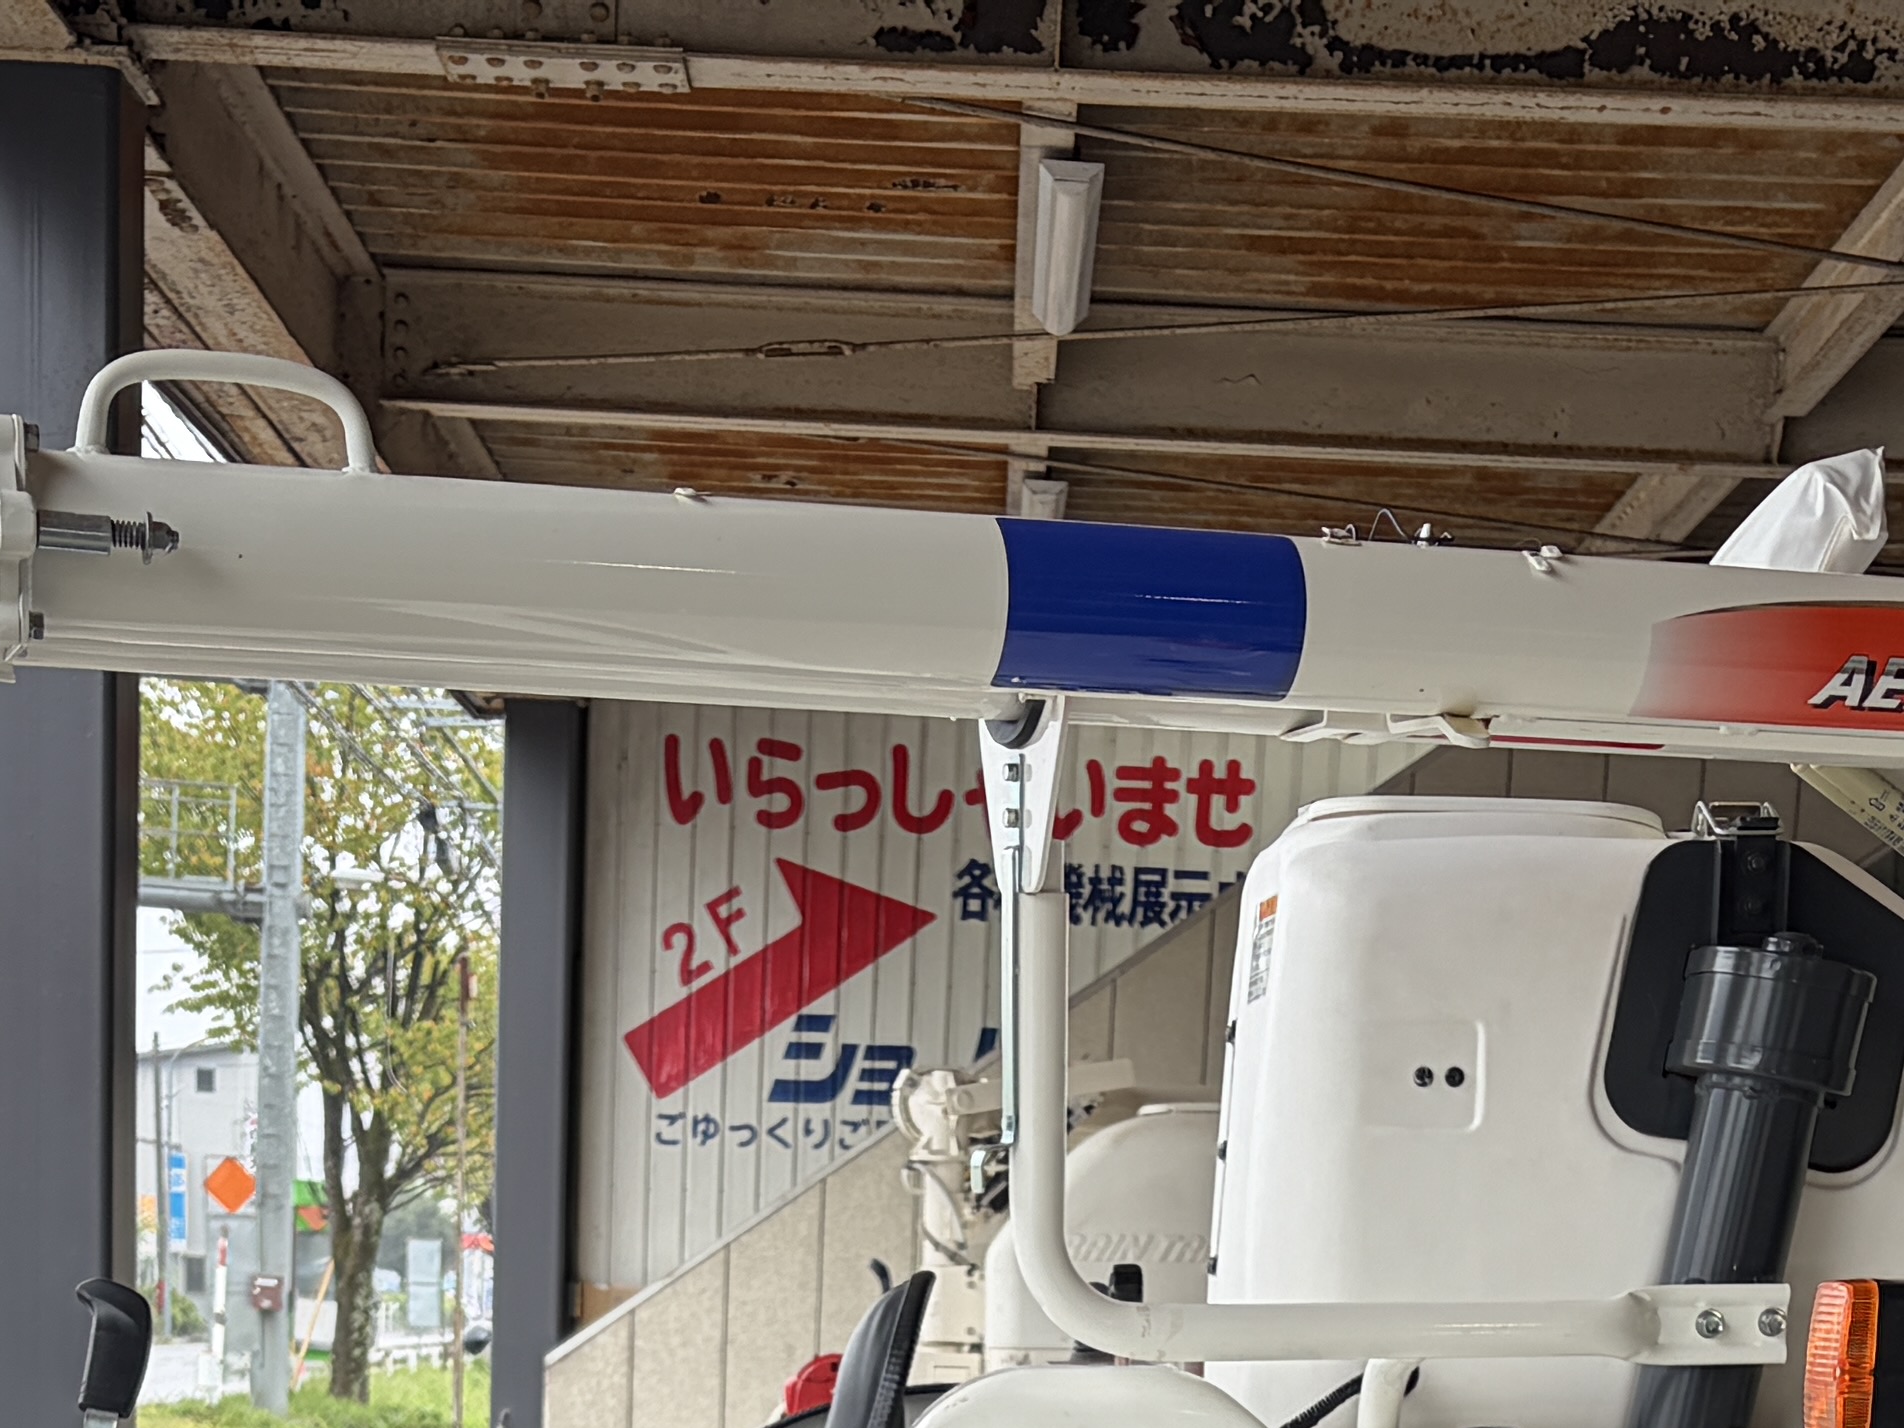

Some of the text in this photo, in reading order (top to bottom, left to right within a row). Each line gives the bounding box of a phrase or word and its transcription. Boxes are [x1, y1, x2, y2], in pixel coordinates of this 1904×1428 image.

[663, 733, 1255, 847] いらっしいませ
[662, 886, 751, 987] 2F
[655, 1111, 890, 1150] ごゆっくりご
